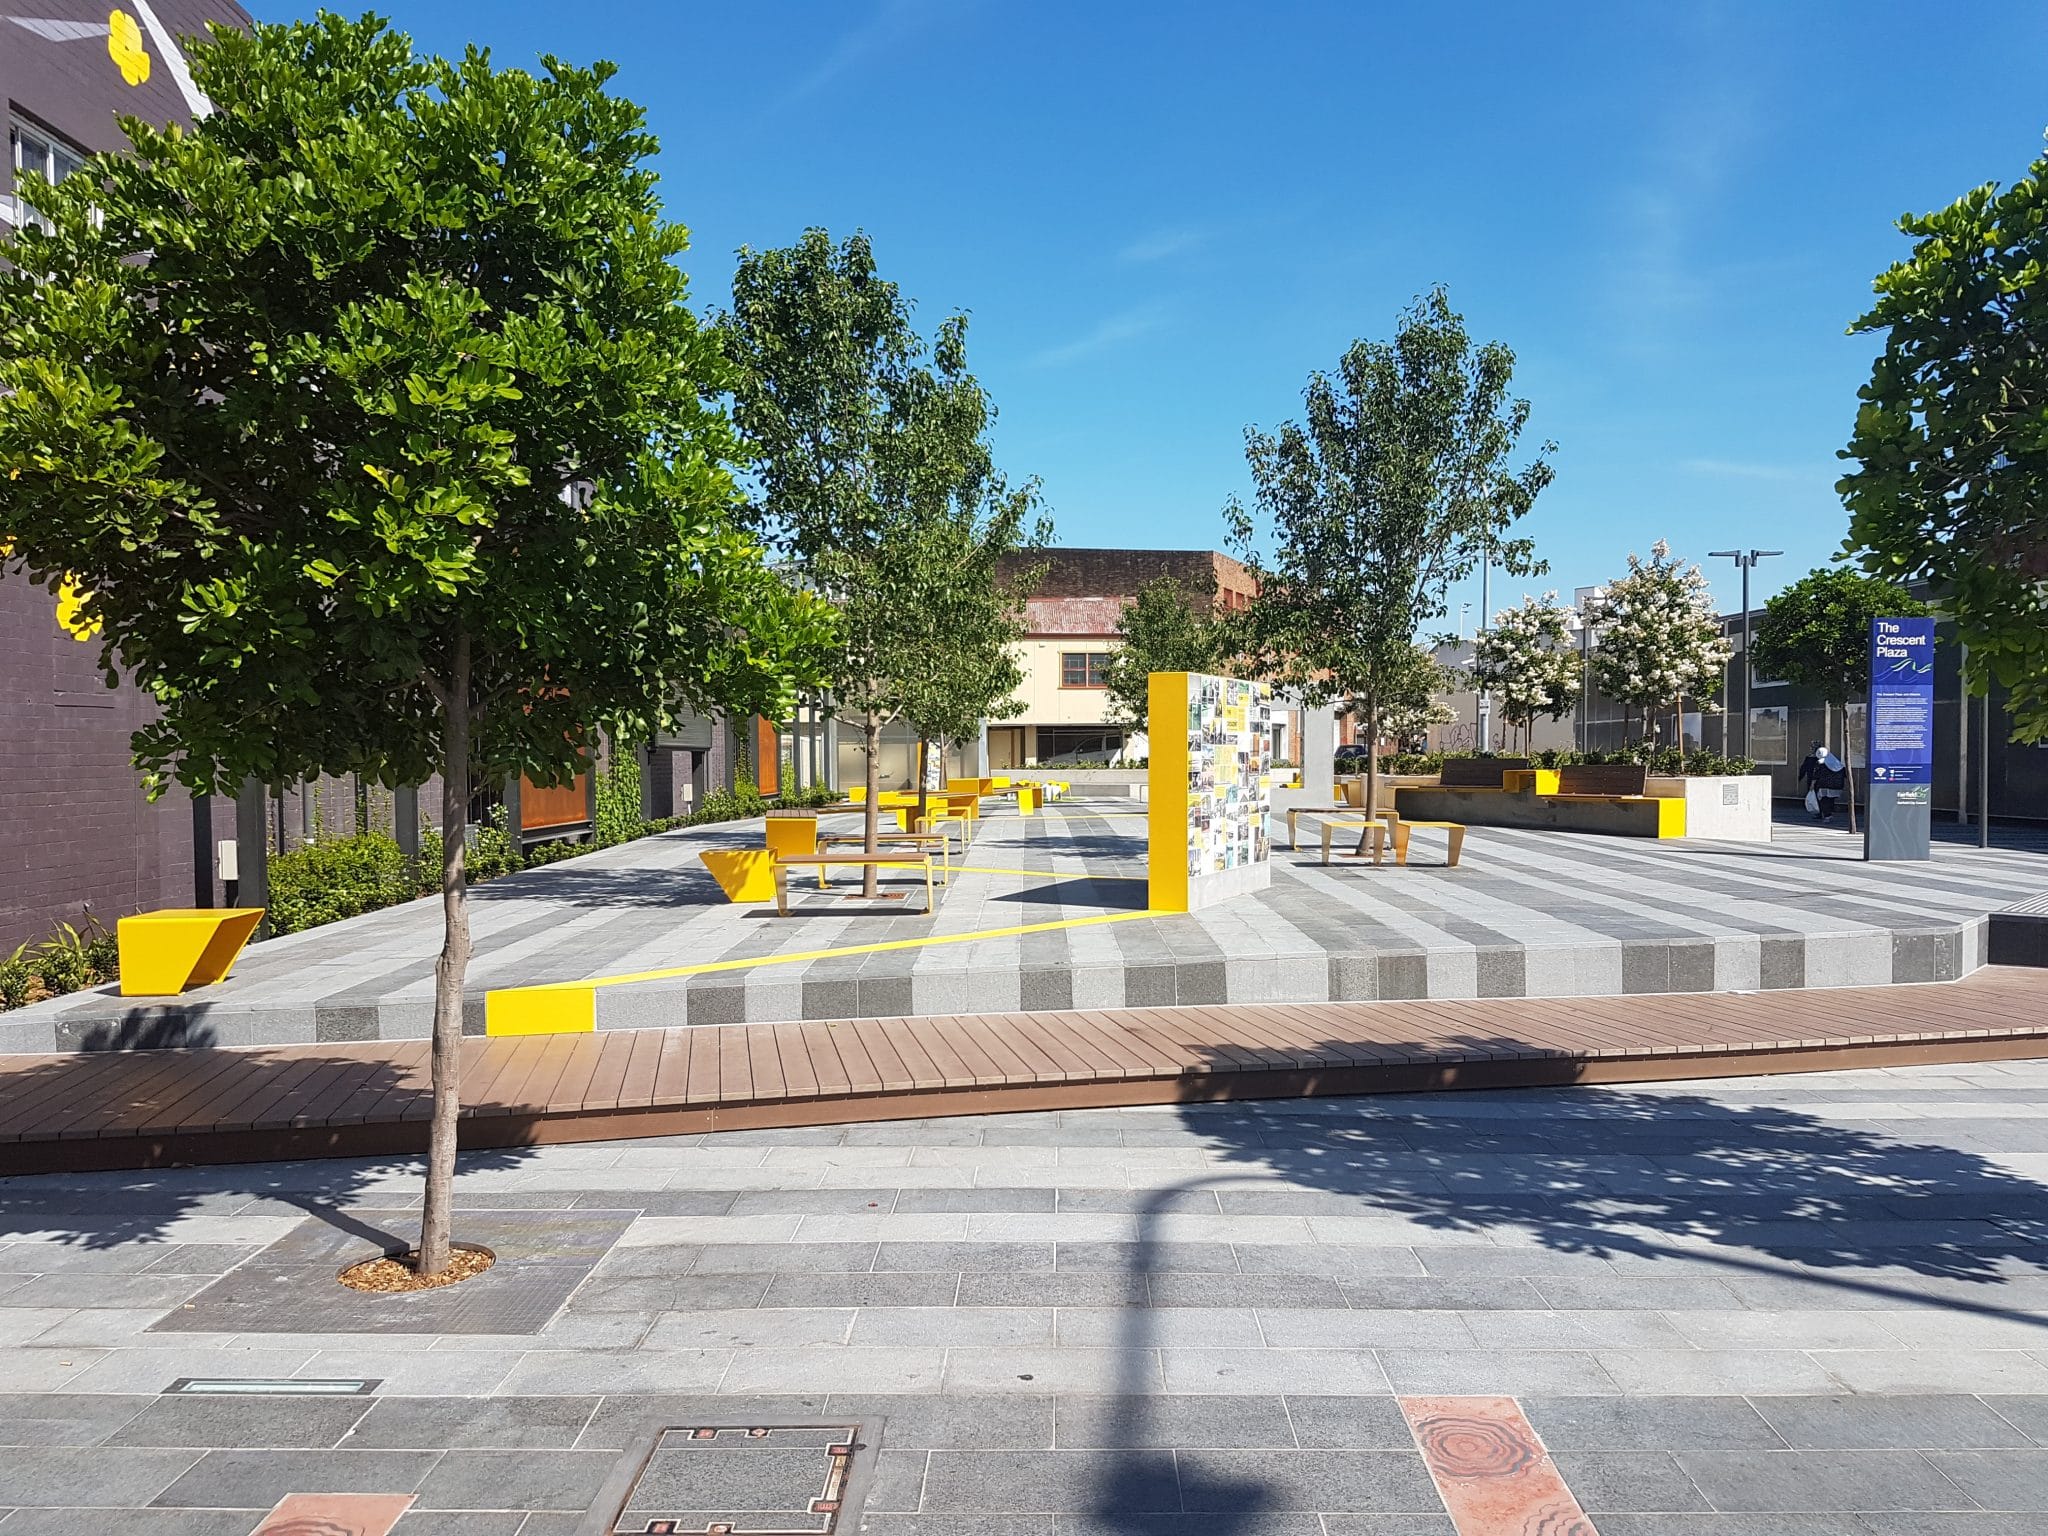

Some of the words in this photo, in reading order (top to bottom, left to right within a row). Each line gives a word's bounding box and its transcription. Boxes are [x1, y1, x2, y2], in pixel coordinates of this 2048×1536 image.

[1877, 622, 1900, 633] The
[1876, 634, 1926, 646] Crescent
[1876, 647, 1908, 658] Plaza
